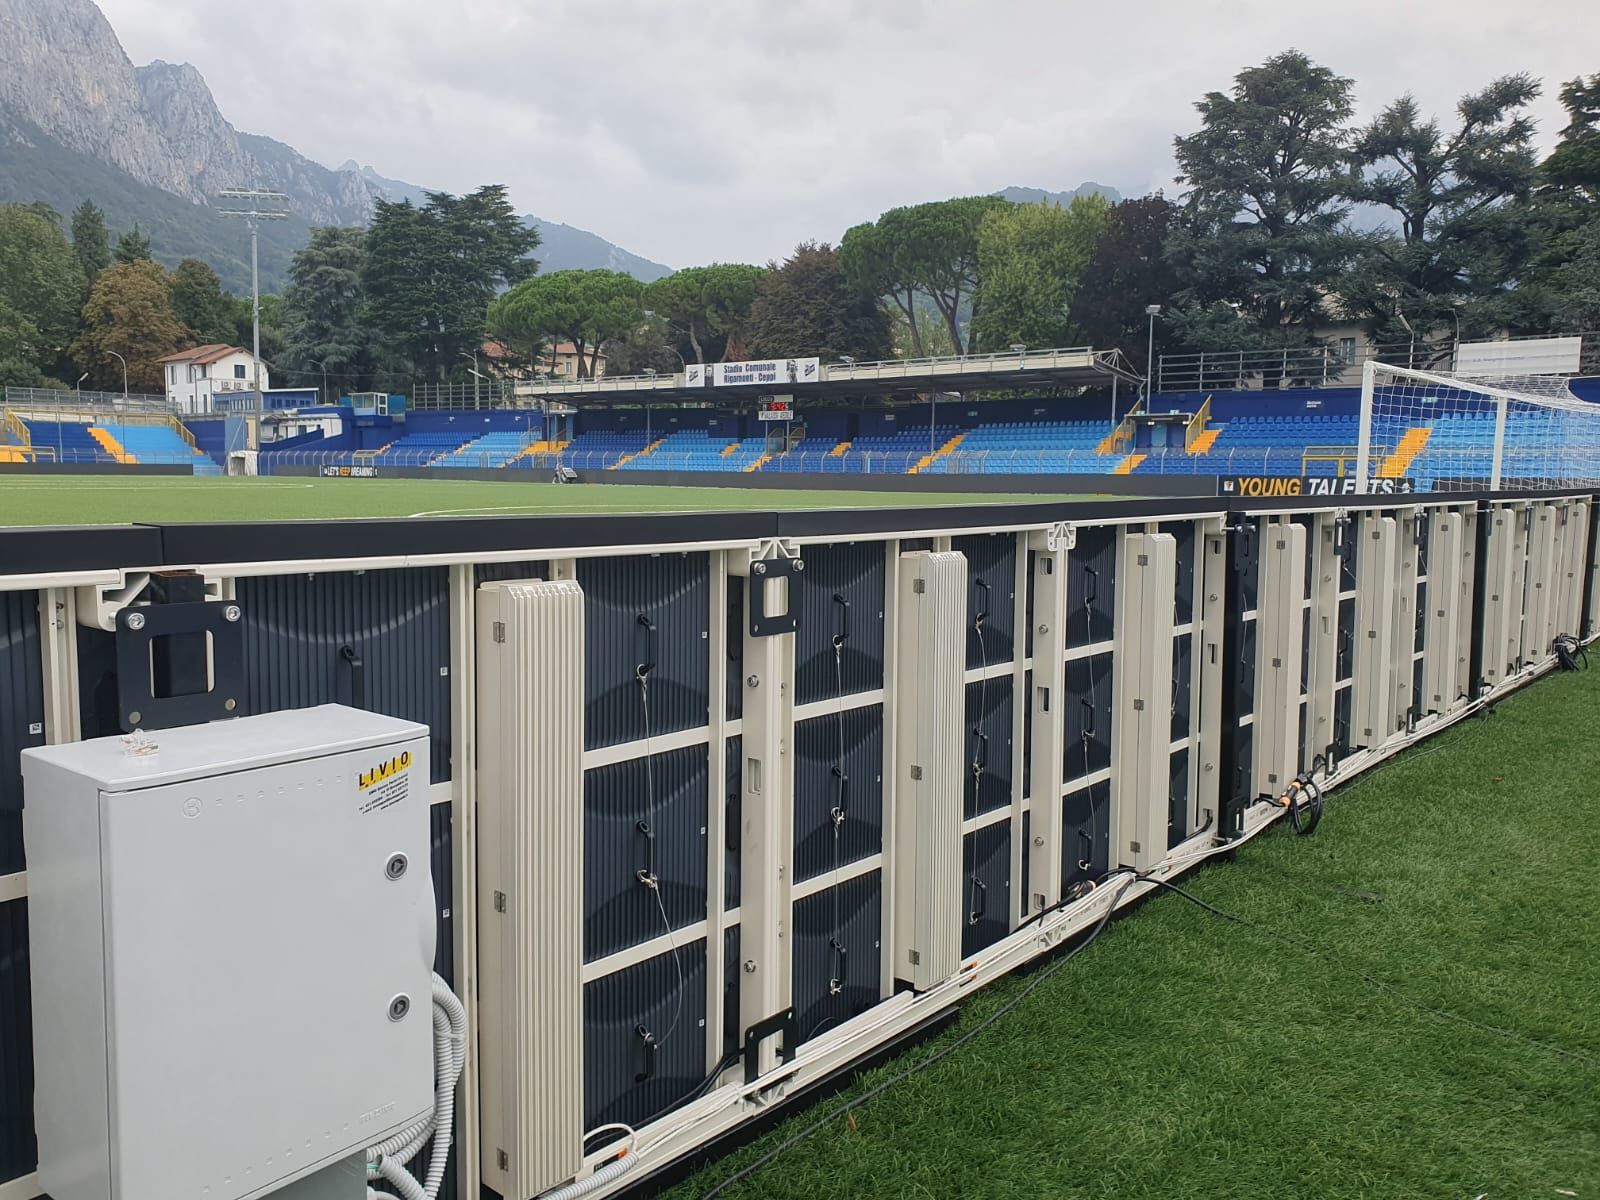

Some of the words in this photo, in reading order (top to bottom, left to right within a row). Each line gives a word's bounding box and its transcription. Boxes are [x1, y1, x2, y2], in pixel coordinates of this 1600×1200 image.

[723, 364, 743, 374] Stadio
[745, 361, 776, 372] Comunale
[758, 371, 776, 382] Ceppi
[1238, 477, 1301, 496] YOUNG
[1309, 478, 1394, 495] TALETS
[359, 751, 409, 787] LIVIO
